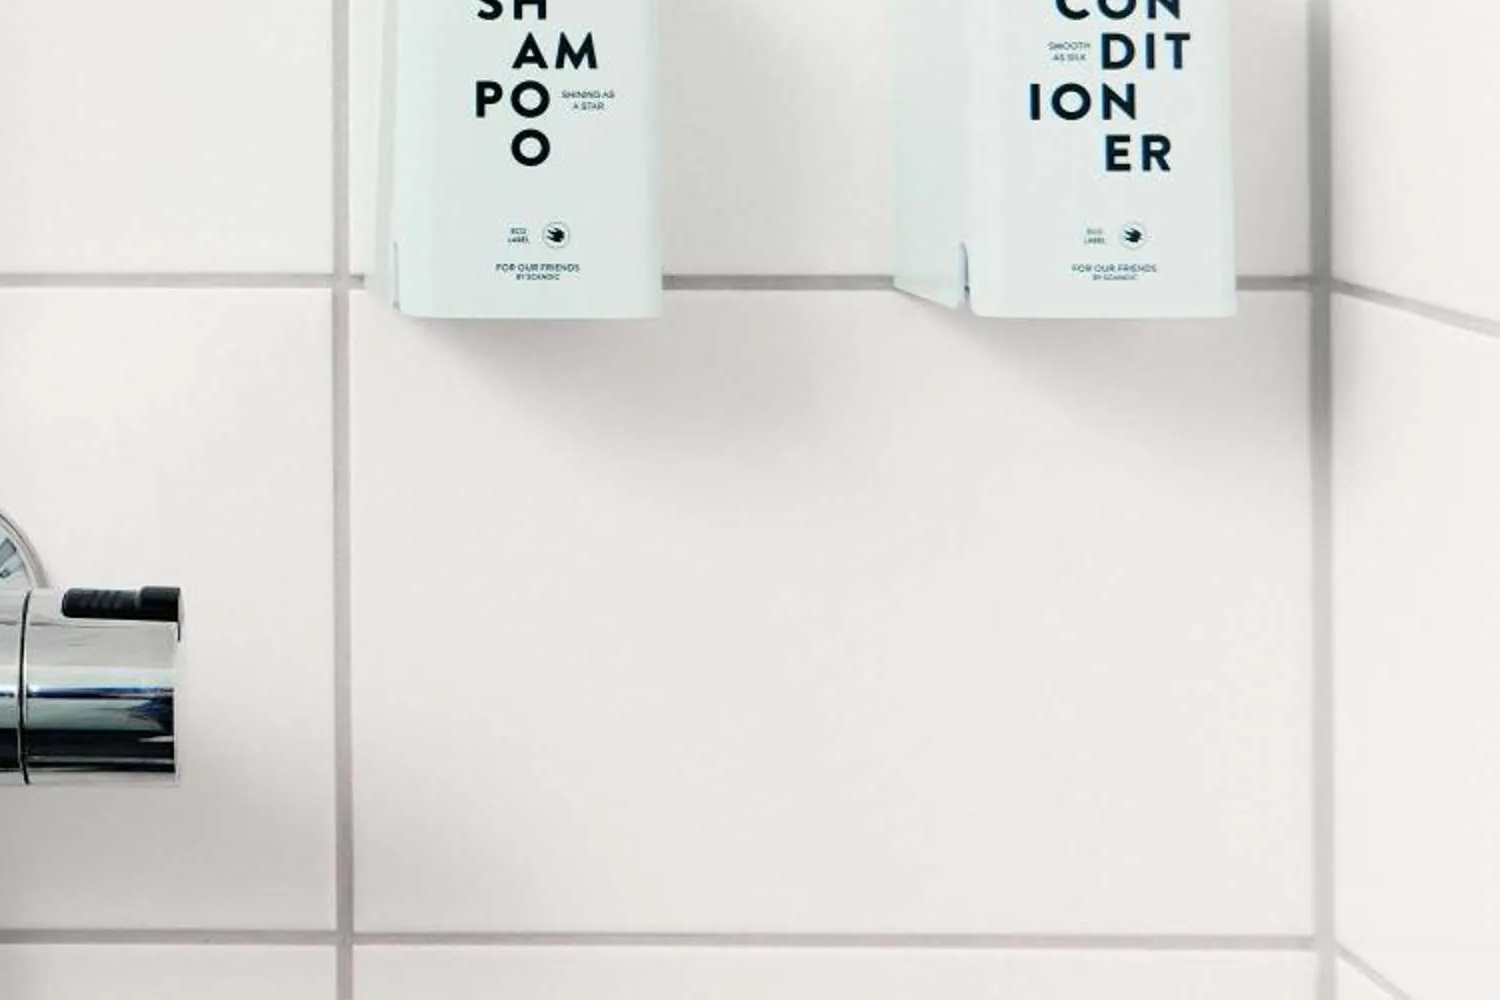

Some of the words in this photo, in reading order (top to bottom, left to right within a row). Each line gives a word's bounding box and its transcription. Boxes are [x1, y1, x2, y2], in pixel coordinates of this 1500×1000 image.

[511, 31, 599, 71] AM
[1100, 31, 1192, 71] DIT
[475, 79, 551, 119] PO
[1029, 82, 1137, 121] ION
[510, 128, 551, 168] O
[1104, 133, 1172, 173] ER
[540, 263, 580, 273] FRIENDS
